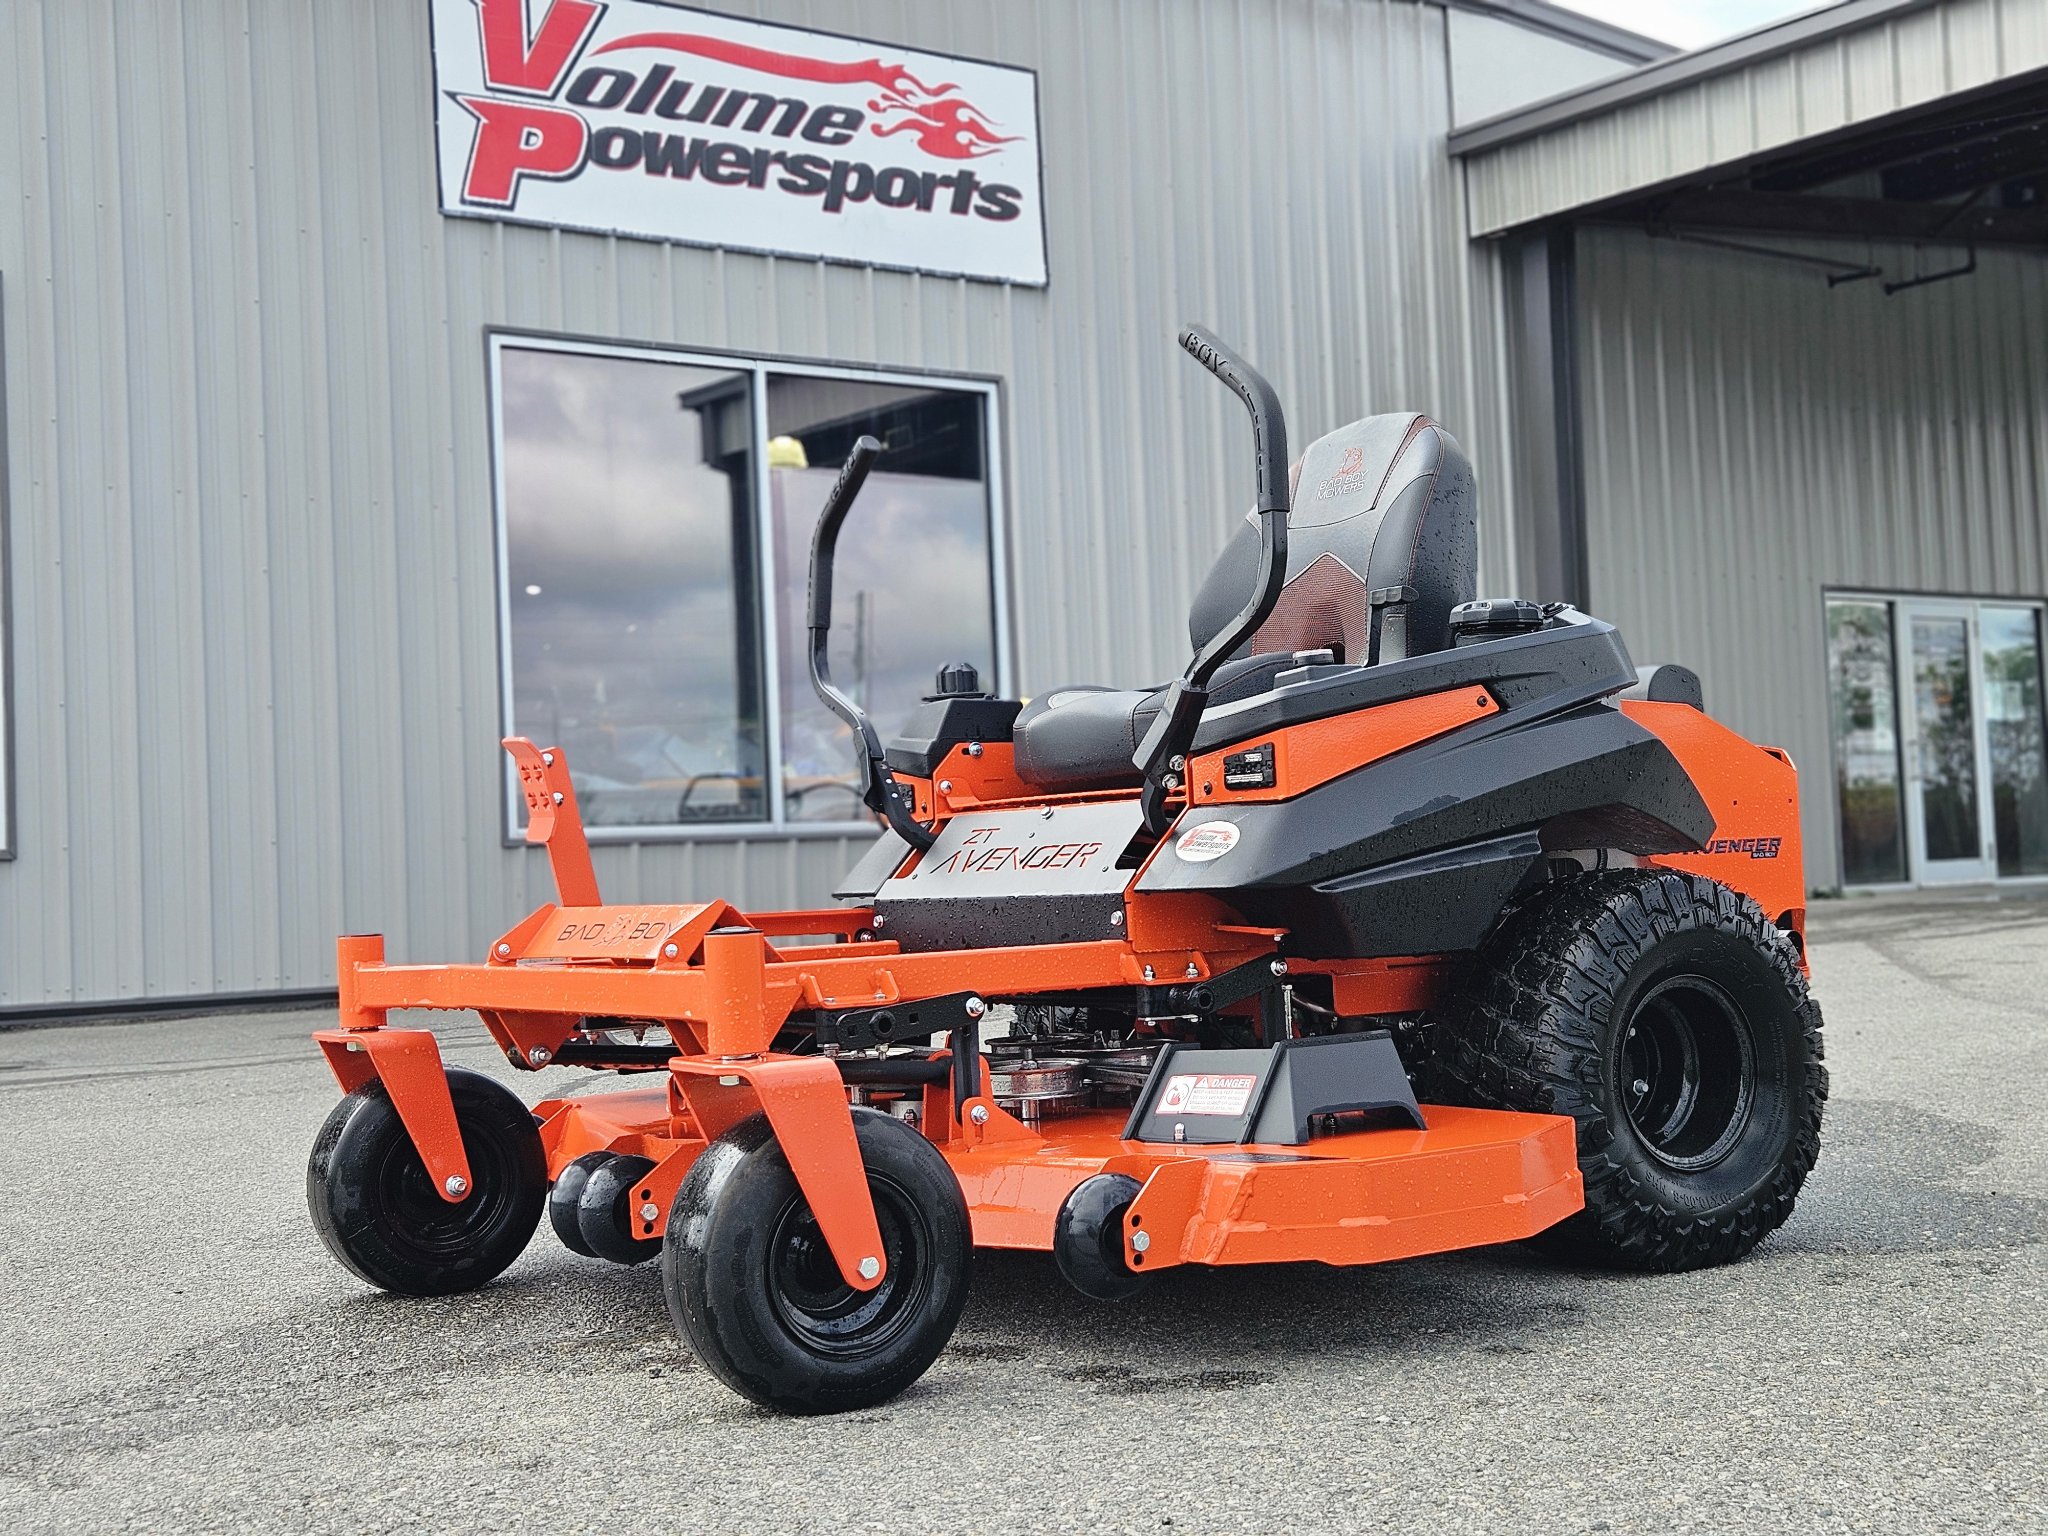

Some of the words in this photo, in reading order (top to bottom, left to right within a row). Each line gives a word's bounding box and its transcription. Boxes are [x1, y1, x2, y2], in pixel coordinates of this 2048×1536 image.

[472, 0, 866, 146] Volume
[443, 90, 1023, 222] Powersports
[1316, 480, 1365, 500] MOWERS
[1319, 476, 1342, 491] BAD
[1344, 469, 1369, 484] BOY
[929, 842, 1102, 874] AVENGER
[557, 923, 605, 941] BAD
[1211, 1078, 1250, 1088] DANGER
